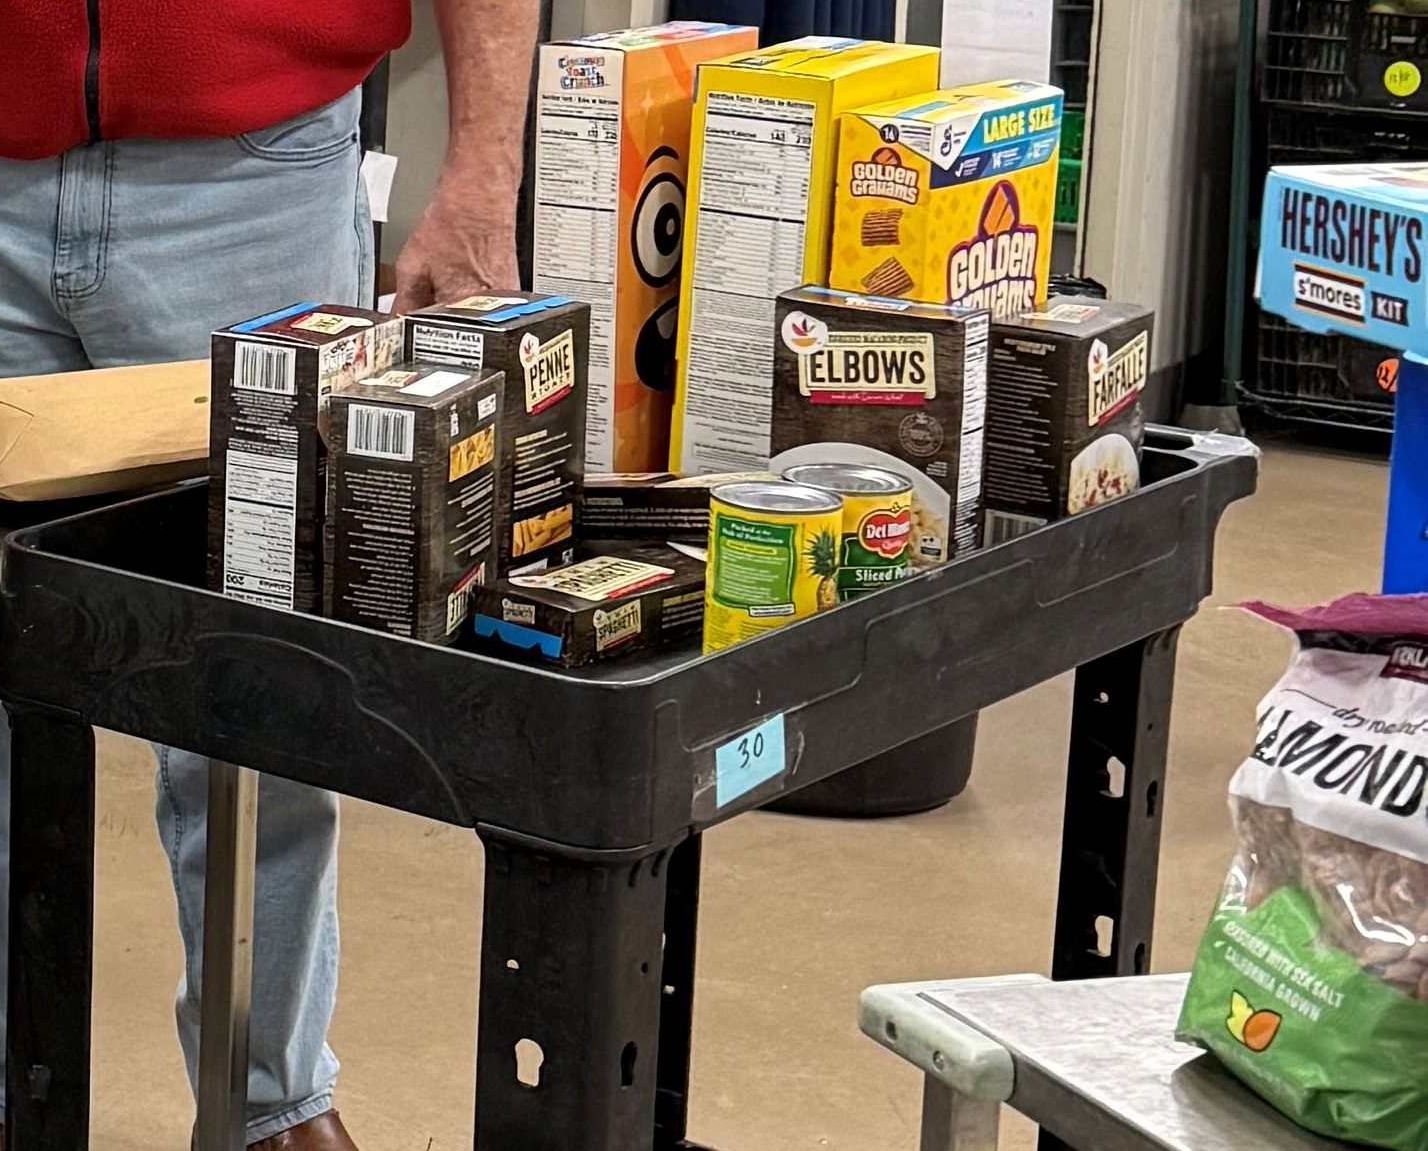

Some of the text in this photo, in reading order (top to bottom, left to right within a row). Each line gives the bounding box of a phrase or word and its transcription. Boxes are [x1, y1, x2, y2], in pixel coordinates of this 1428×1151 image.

[984, 104, 1055, 143] LARGE SIZE
[1281, 187, 1422, 283] HERSHEY'S
[1298, 277, 1402, 321] s'mores KIT
[456, 331, 480, 343] Facts
[530, 344, 570, 390] PENNE
[810, 350, 925, 384] ELBOWS
[1094, 345, 1145, 413] FARFALLE
[866, 524, 886, 538] Del
[855, 568, 892, 582] Sliced
[598, 610, 638, 640] SPAGHETTI
[737, 732, 764, 768] 30
[1275, 983, 1321, 1022] GROWN
[1311, 979, 1344, 1008] SALT
